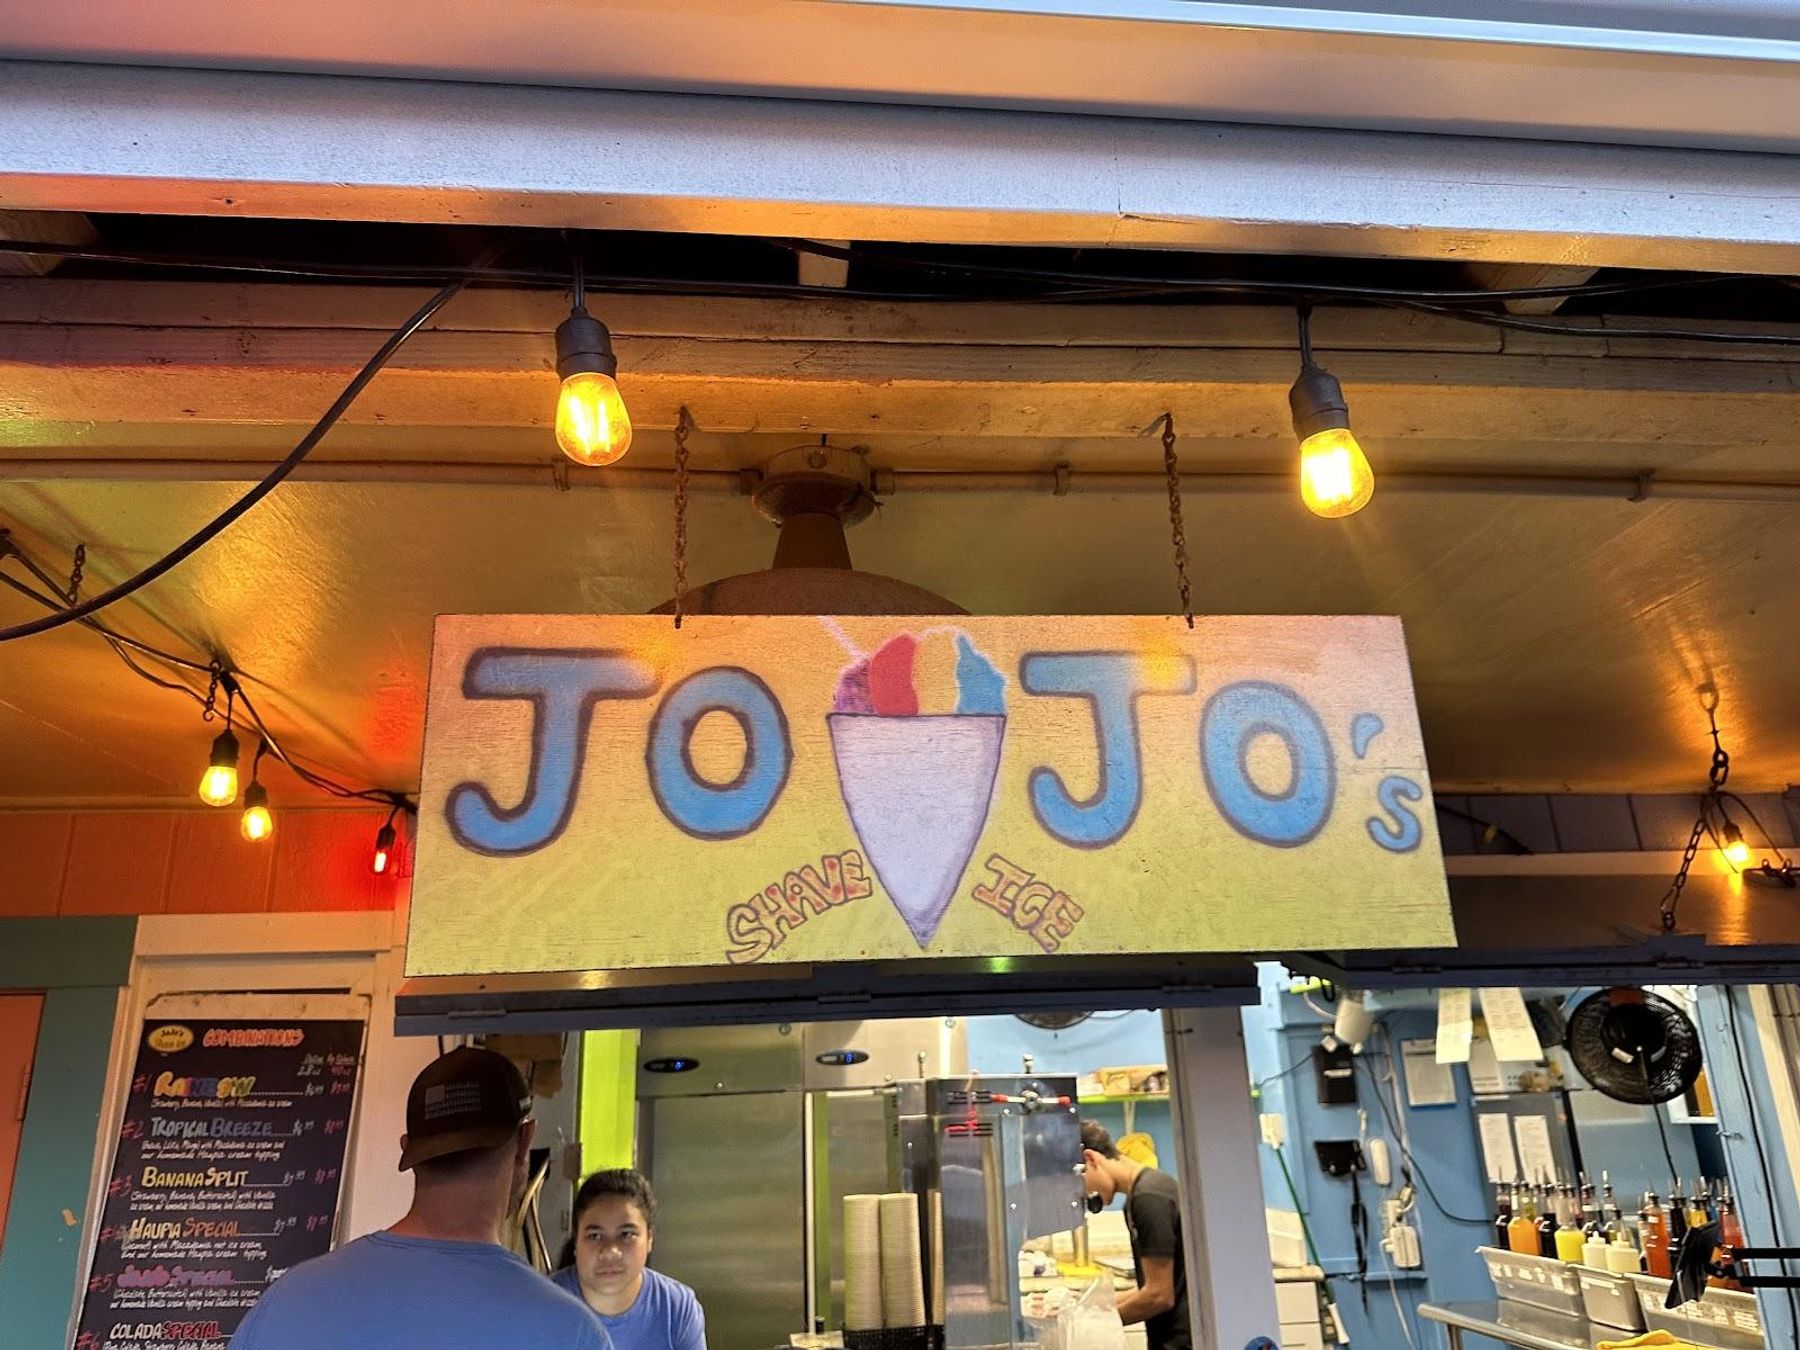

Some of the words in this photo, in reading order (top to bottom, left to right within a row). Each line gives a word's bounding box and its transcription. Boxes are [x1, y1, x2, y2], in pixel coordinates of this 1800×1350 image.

[726, 849, 873, 965] SHAVE
[971, 853, 1084, 952] ICE
[120, 1119, 145, 1140] #2
[151, 1116, 209, 1138] TROPICAL
[210, 1116, 273, 1137] BREEZE
[110, 1174, 133, 1196] #3
[141, 1166, 205, 1188] BANANA
[205, 1167, 249, 1188] SPLIT
[129, 1217, 181, 1239] HAUPIA
[182, 1217, 240, 1238] SPECIAL
[109, 1322, 162, 1341] COLADA
